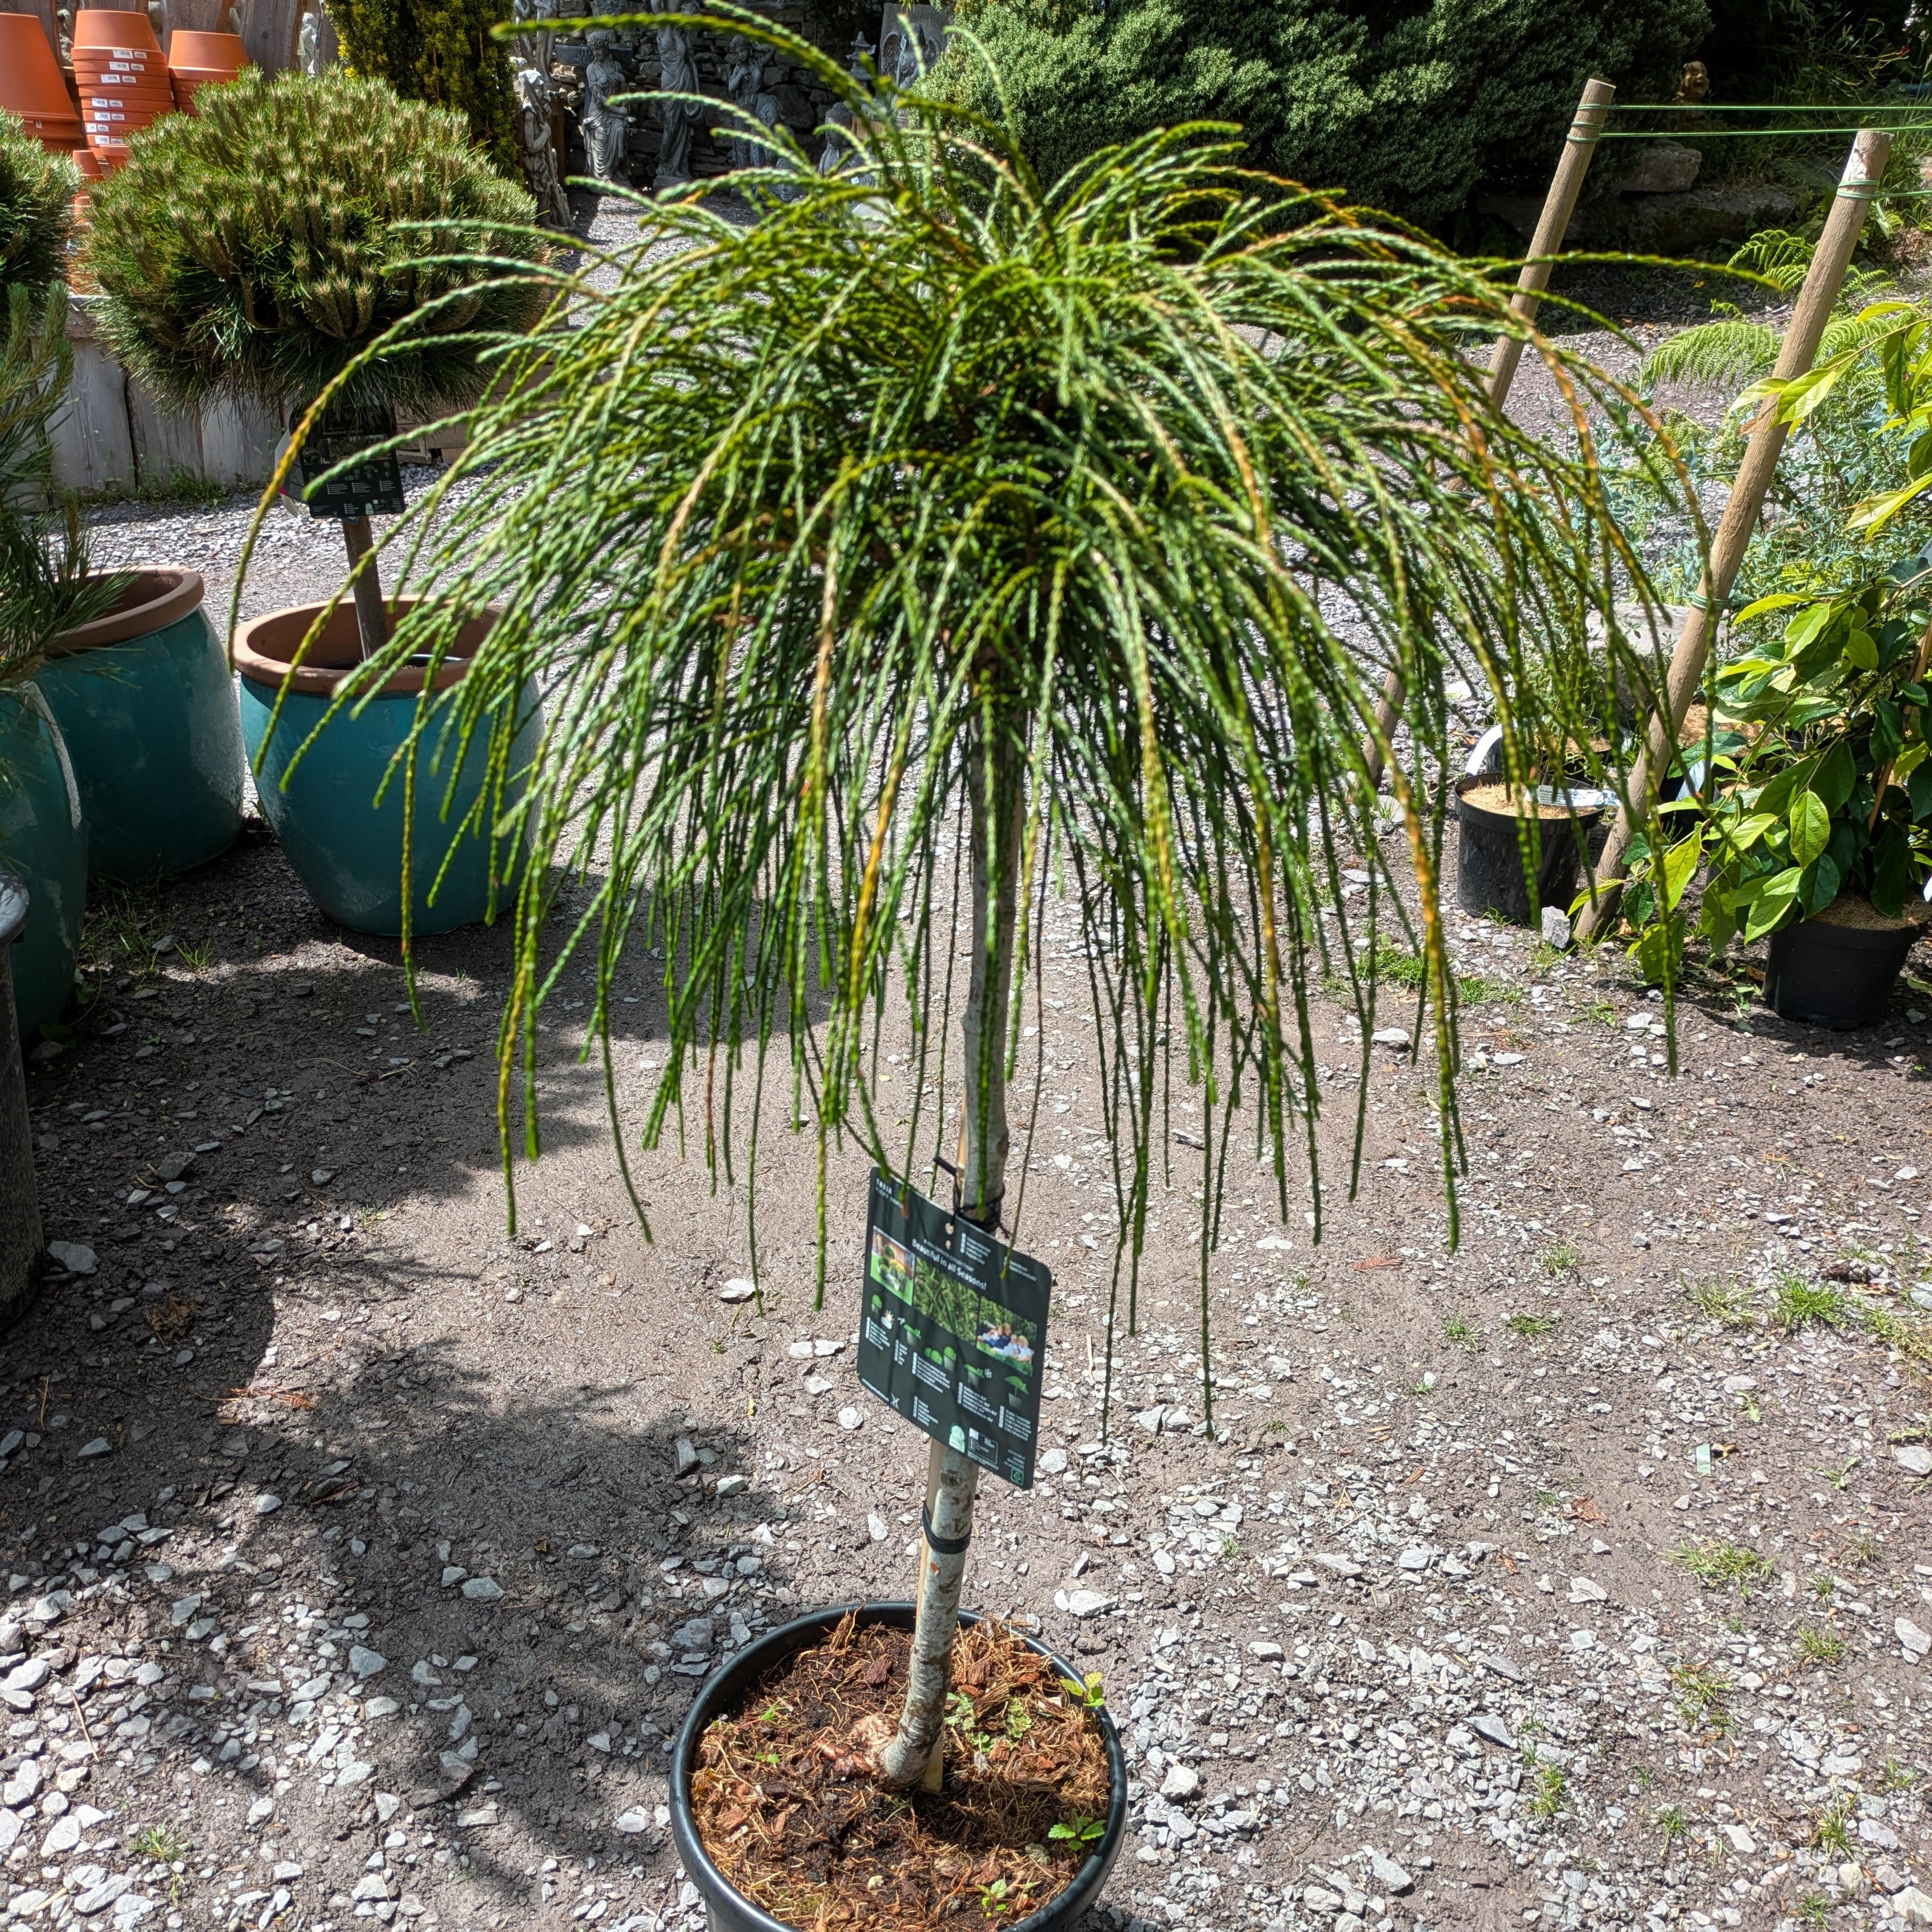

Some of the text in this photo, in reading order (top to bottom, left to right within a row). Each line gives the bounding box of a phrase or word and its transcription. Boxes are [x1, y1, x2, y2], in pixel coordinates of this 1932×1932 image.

[912, 1238, 940, 1263] Beautiful
[940, 1256, 947, 1268] in
[947, 1263, 956, 1273] all
